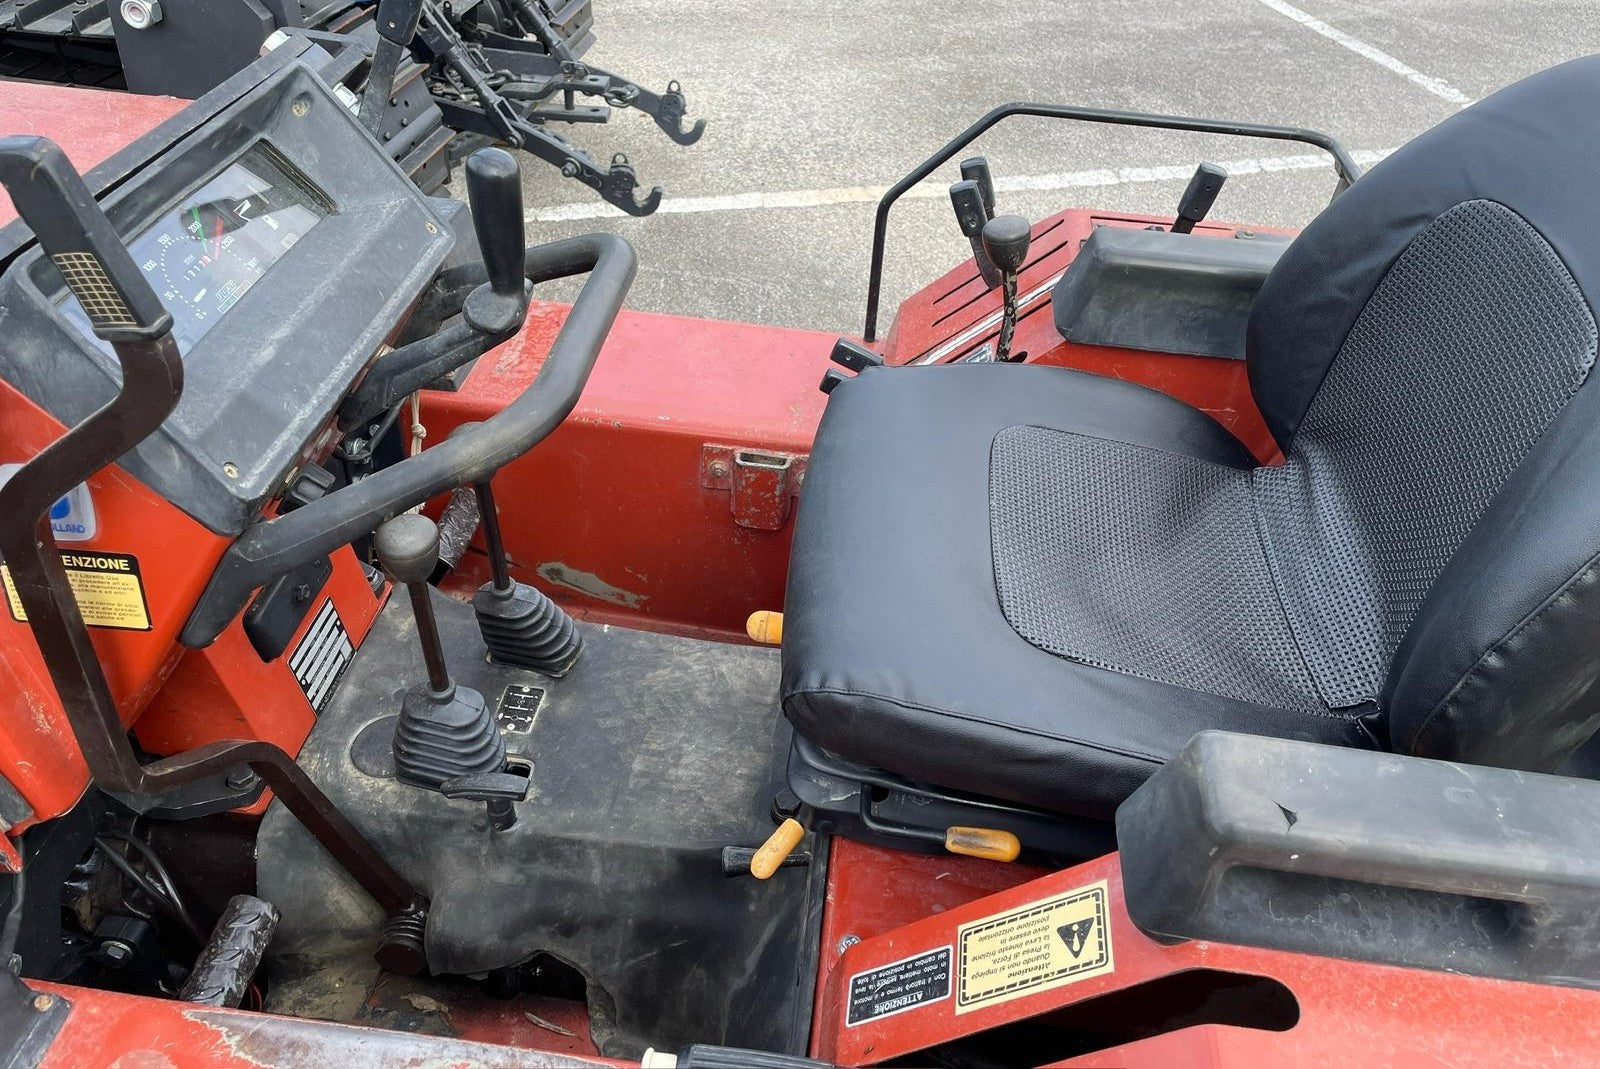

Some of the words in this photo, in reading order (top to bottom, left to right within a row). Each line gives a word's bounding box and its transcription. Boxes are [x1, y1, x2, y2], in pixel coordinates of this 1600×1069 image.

[142, 260, 157, 272] 1000
[52, 523, 85, 534] LLAND
[60, 555, 130, 571] ENZIONE
[1017, 915, 1050, 930] posizione
[979, 927, 1014, 943] orizzontale
[1032, 925, 1050, 934] deve
[1009, 931, 1031, 942] essere
[1025, 937, 1041, 946] Leva
[998, 942, 1023, 954] innesto
[1022, 946, 1041, 955] Presa
[914, 956, 936, 966] cambio
[938, 952, 946, 960] del
[971, 950, 996, 962] frizione
[1014, 952, 1020, 960] di
[1022, 952, 1050, 965] Quando
[924, 964, 938, 973] moto
[1008, 961, 1021, 969] non
[1008, 962, 1051, 978] Attenzione
[879, 965, 905, 978] posizione
[972, 968, 998, 979] impiega
[886, 986, 903, 995] fermo
[854, 995, 873, 1005] motore
[873, 992, 923, 1014] ATTENZIONE
